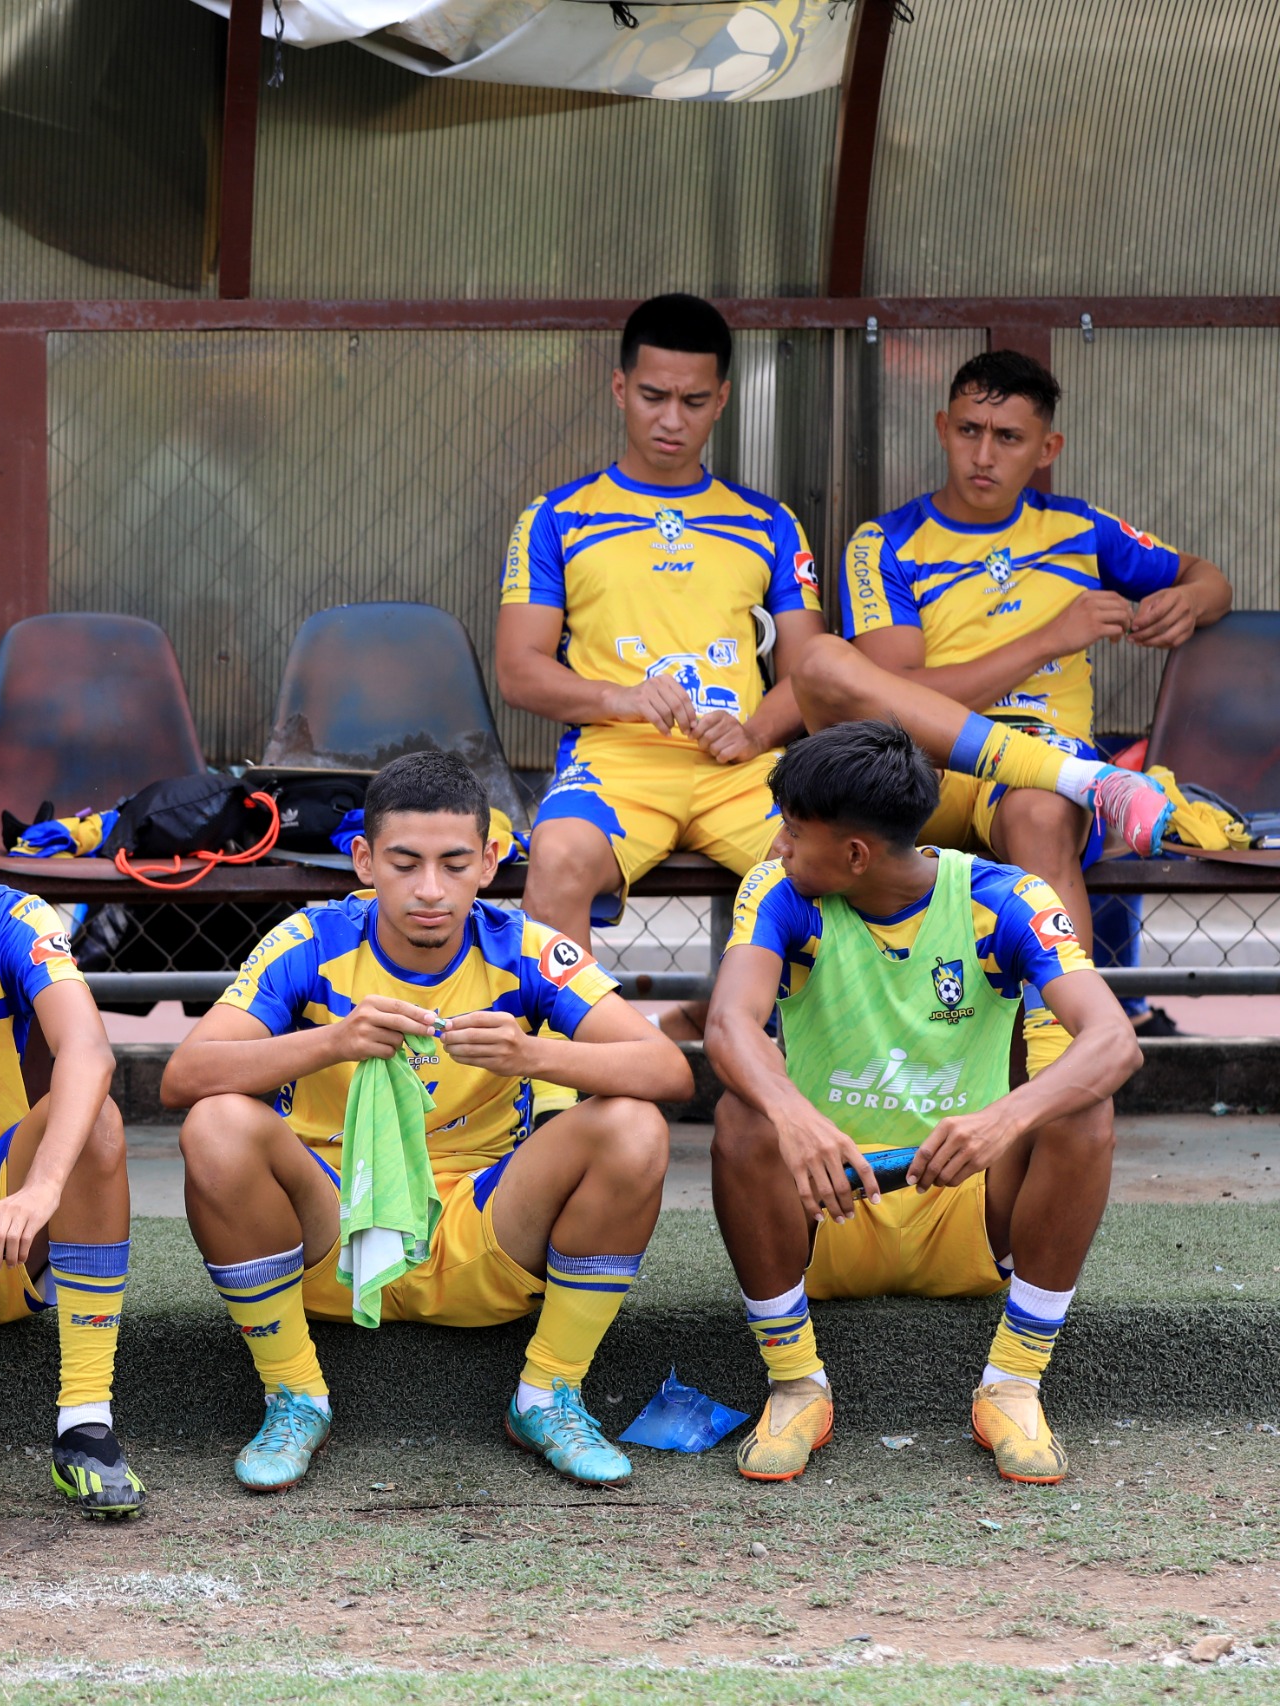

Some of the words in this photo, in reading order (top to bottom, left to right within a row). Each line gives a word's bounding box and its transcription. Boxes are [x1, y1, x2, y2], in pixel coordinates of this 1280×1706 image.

[853, 545, 874, 598] JOCORO
[739, 862, 777, 899] OCORO
[929, 1008, 974, 1021] JOCORO
[948, 1017, 959, 1025] FC
[407, 1055, 440, 1065] CORO
[827, 1087, 968, 1114] BORDADOS
